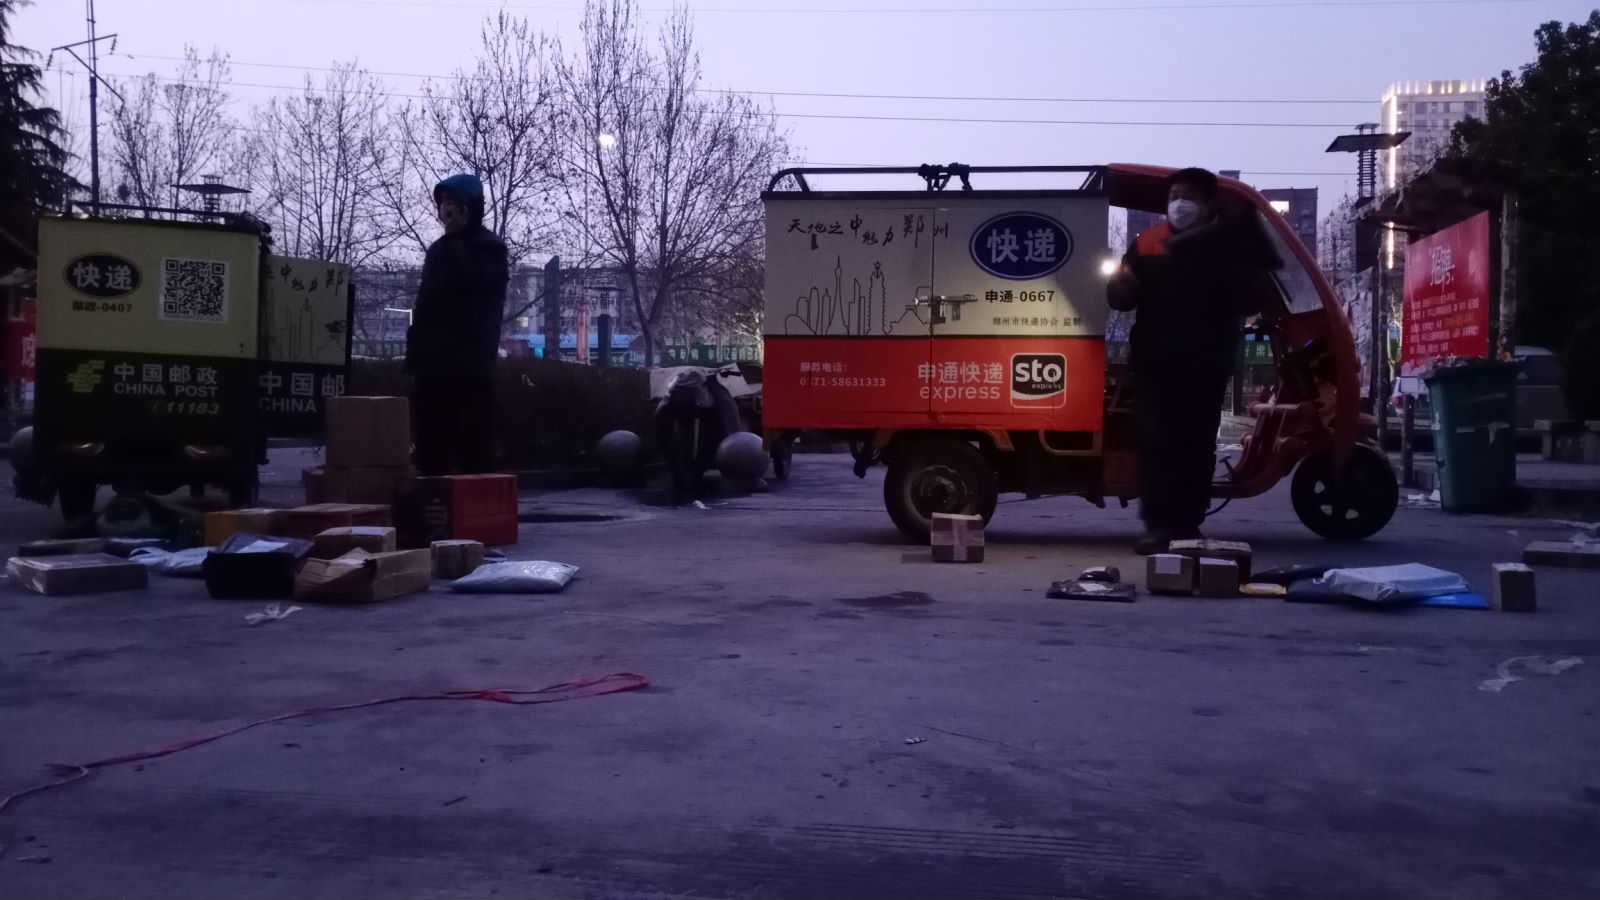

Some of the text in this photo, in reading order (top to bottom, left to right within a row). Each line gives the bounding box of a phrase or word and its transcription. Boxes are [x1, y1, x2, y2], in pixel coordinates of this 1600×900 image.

[986, 227, 1057, 263] 快递
[73, 261, 133, 291] 快递
[985, 289, 1056, 304] 申通-0667
[72, 301, 132, 313] 邮政-0407
[113, 362, 219, 385] 中国邮政
[917, 361, 1004, 385] 申通快递
[1015, 358, 1063, 383] sto
[113, 382, 219, 398] CHINA POST
[258, 370, 346, 397] 中国邮
[800, 376, 887, 388] 071-58631333
[919, 385, 1001, 402] express
[258, 396, 318, 414] CHINA
